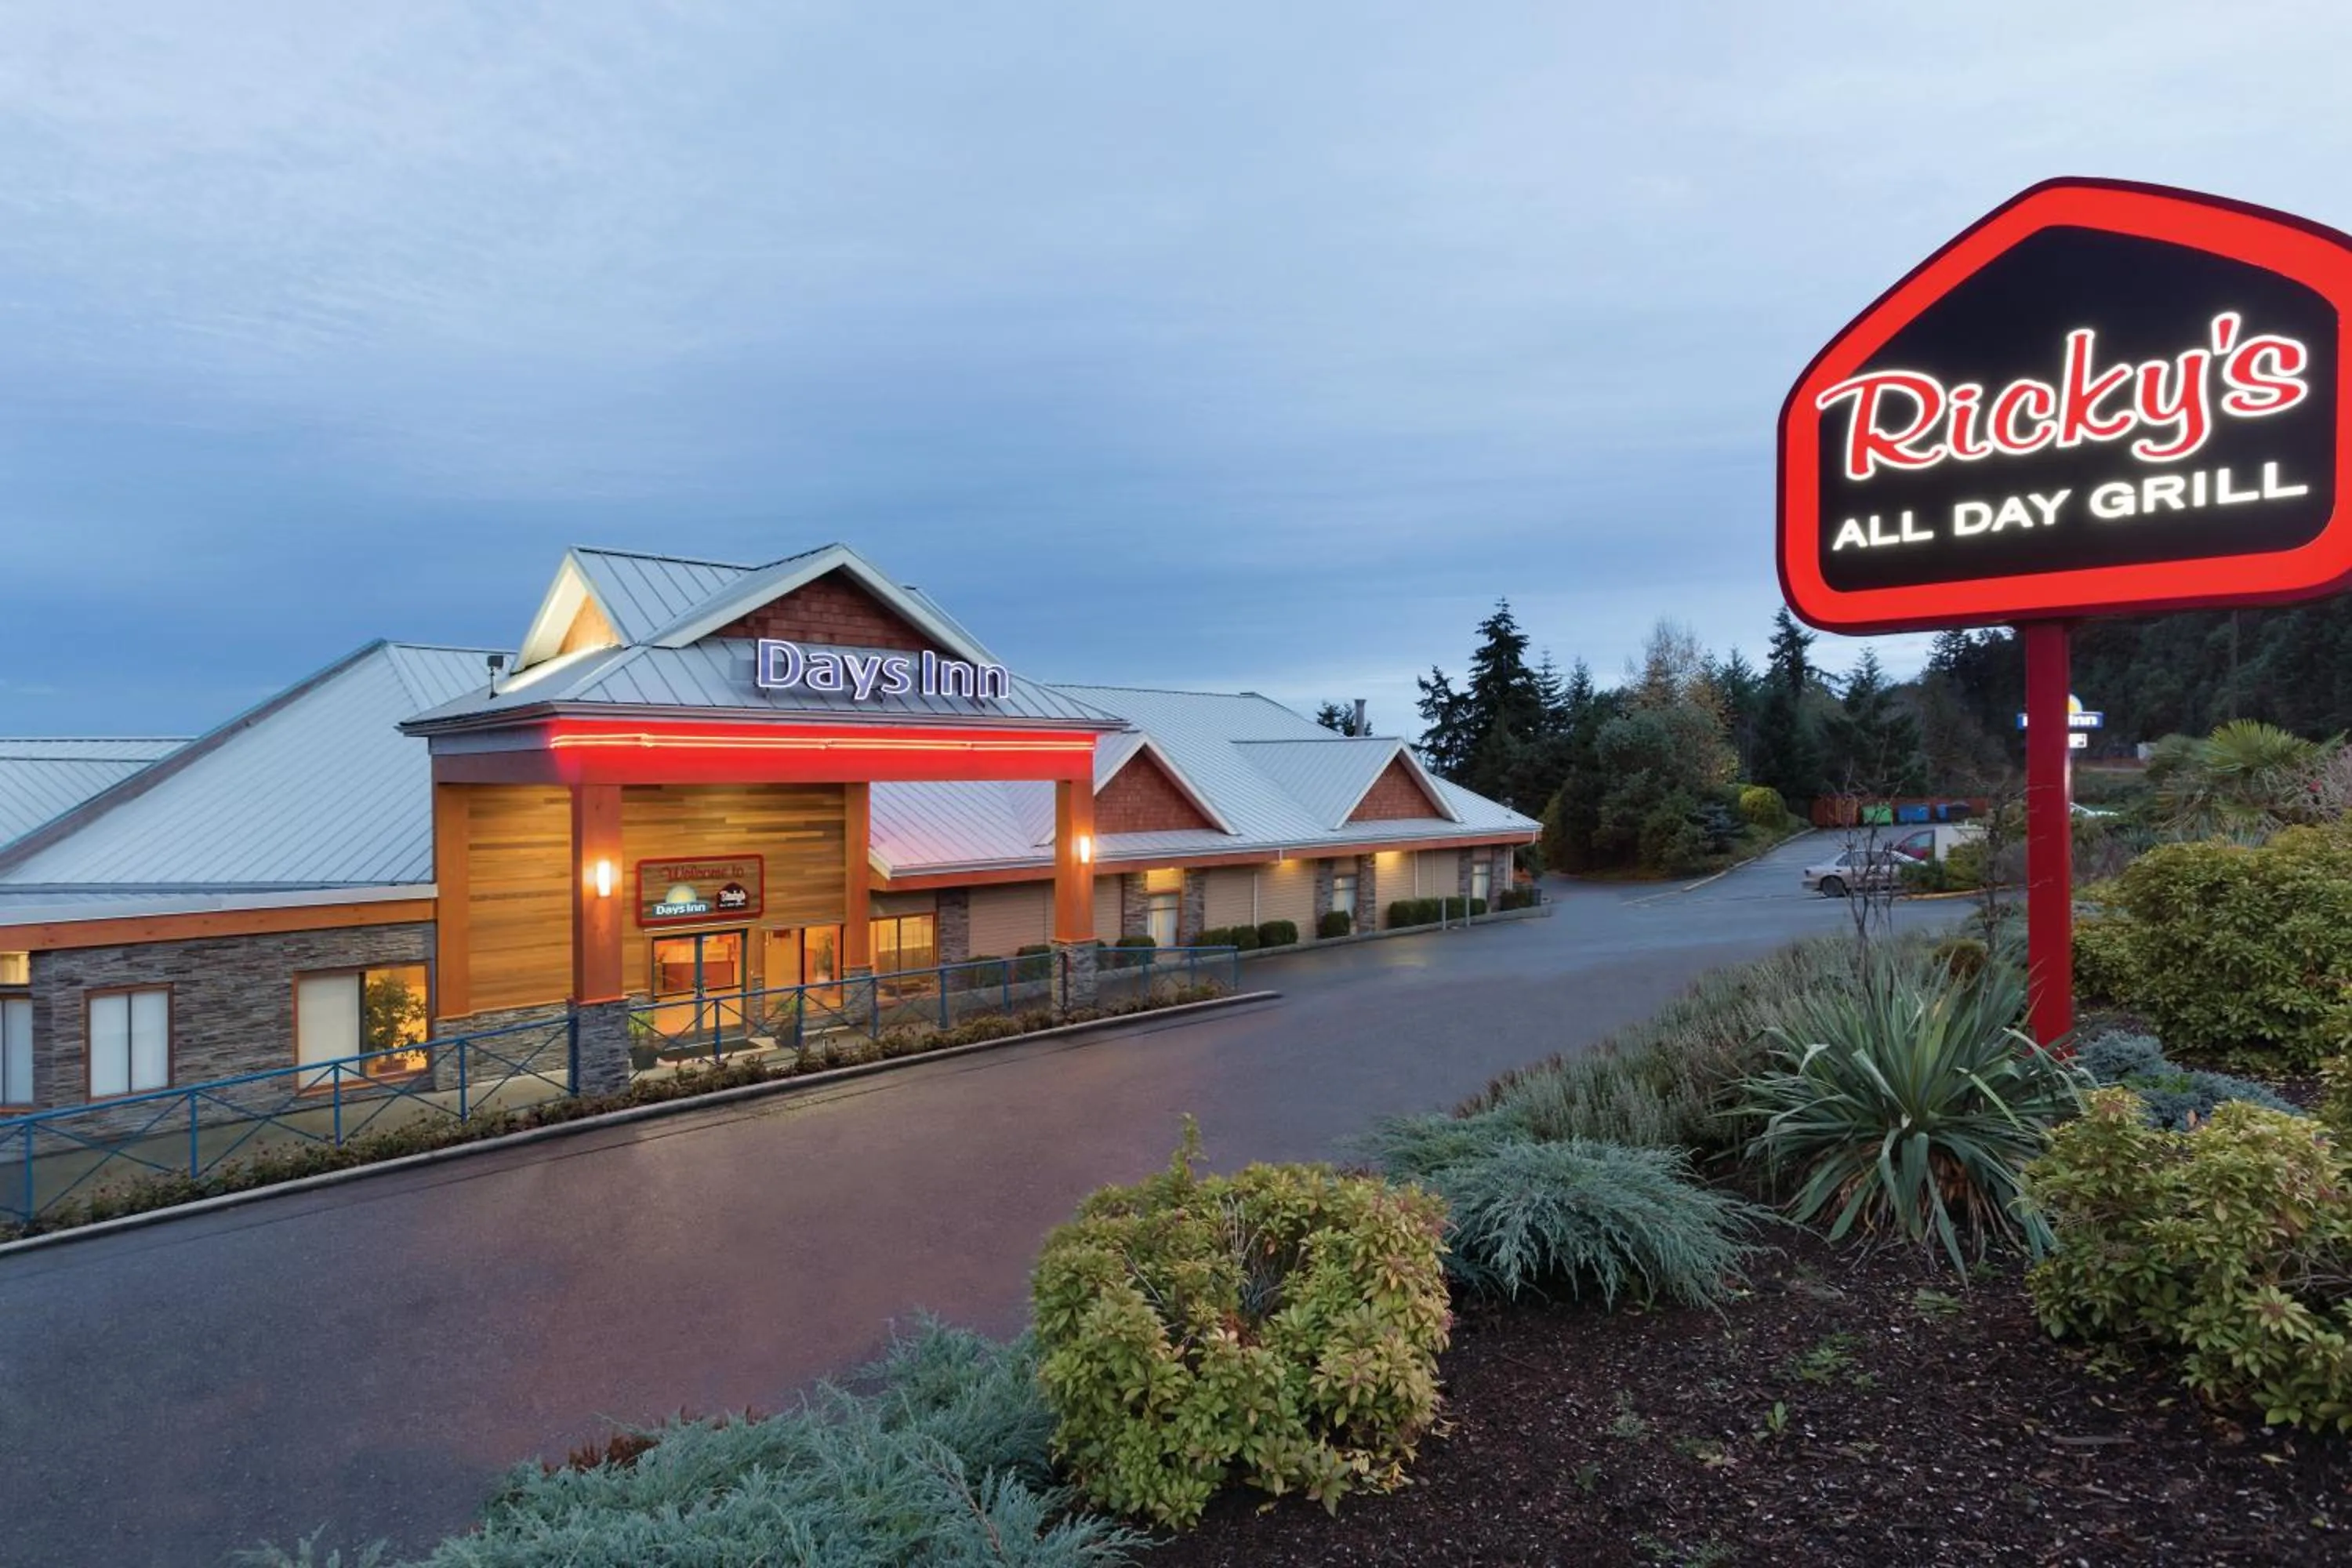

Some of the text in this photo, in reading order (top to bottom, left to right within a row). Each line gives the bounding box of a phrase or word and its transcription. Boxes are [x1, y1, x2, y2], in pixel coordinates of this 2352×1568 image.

[1815, 311, 2309, 480] Ricky's
[1832, 462, 2308, 551] ALL DAY GRILL
[757, 638, 1009, 700] Days Inn
[656, 903, 706, 916] Days Inn
